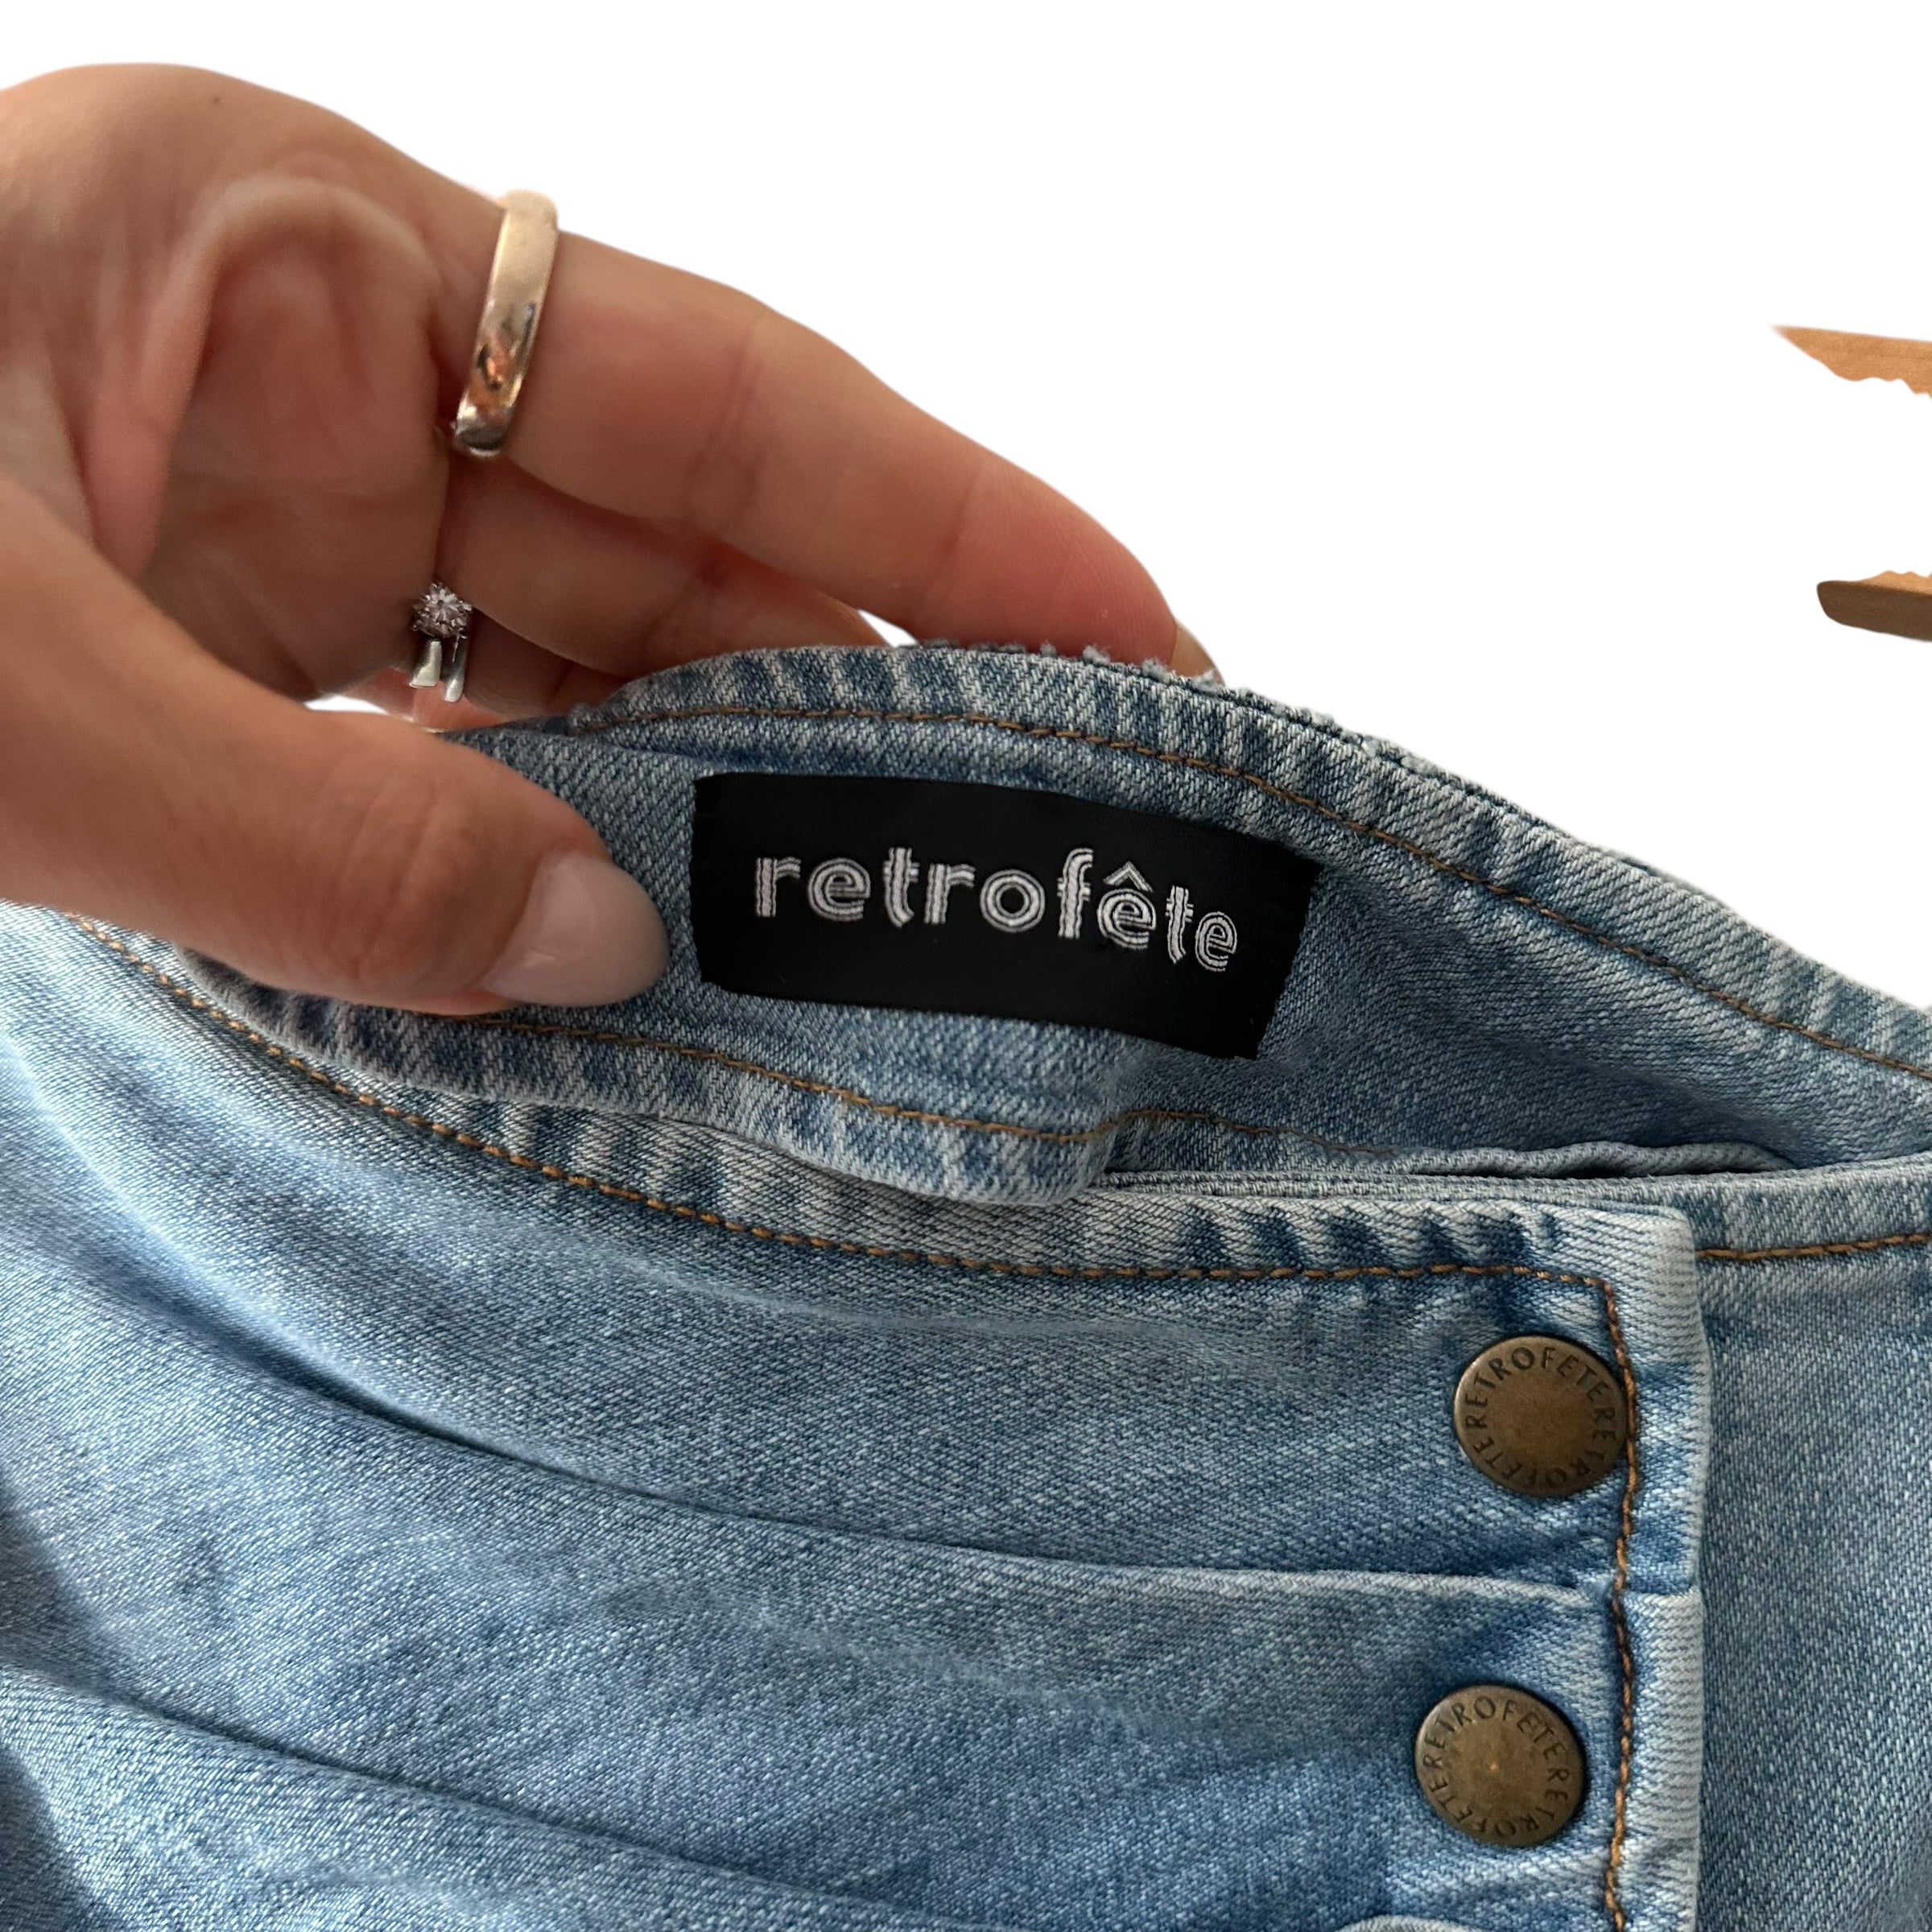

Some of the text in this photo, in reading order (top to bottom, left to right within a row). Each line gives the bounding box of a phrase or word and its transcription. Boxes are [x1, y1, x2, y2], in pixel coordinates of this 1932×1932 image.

[754, 846, 1237, 972] retrofête
[1465, 1346, 1609, 1430] RETROFETE
[1422, 1695, 1567, 1770] RETROFETE
